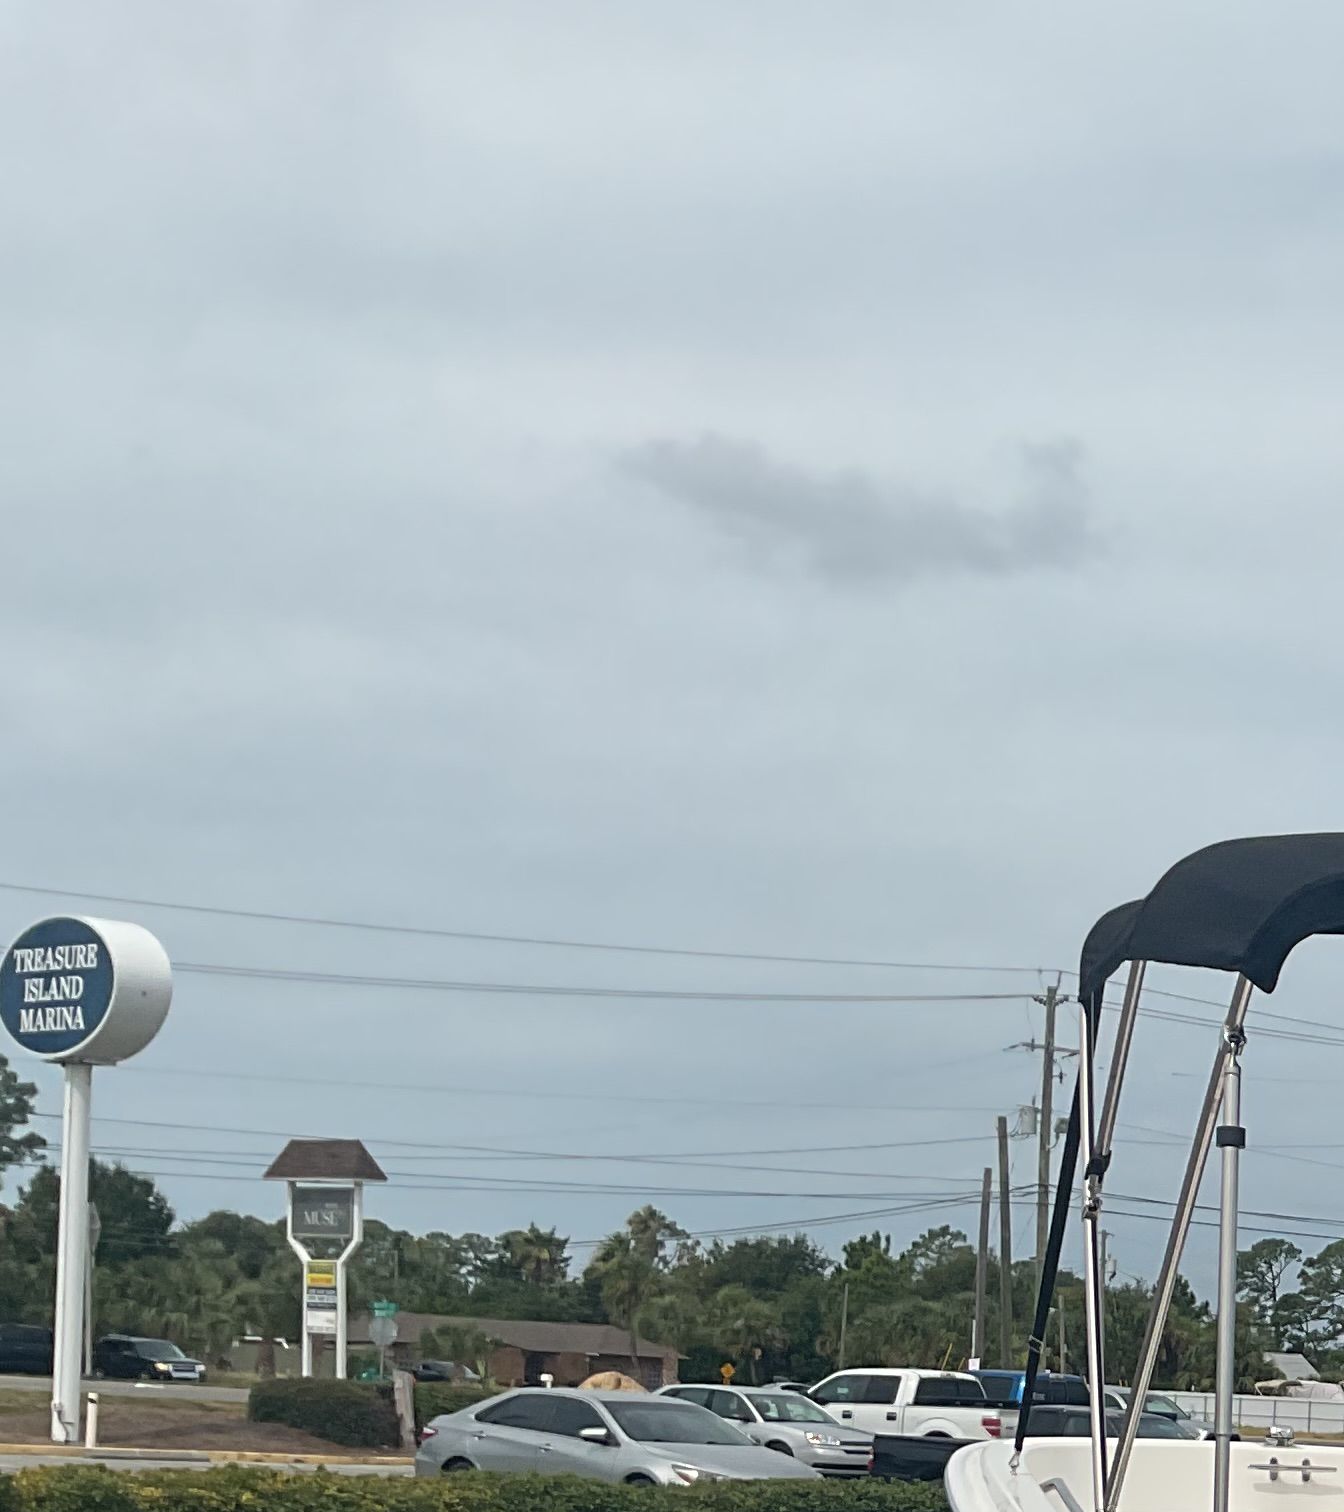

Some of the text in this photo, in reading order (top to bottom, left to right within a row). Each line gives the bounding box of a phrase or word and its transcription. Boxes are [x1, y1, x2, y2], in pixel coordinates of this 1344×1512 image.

[13, 943, 98, 974] TREASURE
[24, 975, 84, 1003] ISLAND
[19, 1006, 85, 1032] MARINA
